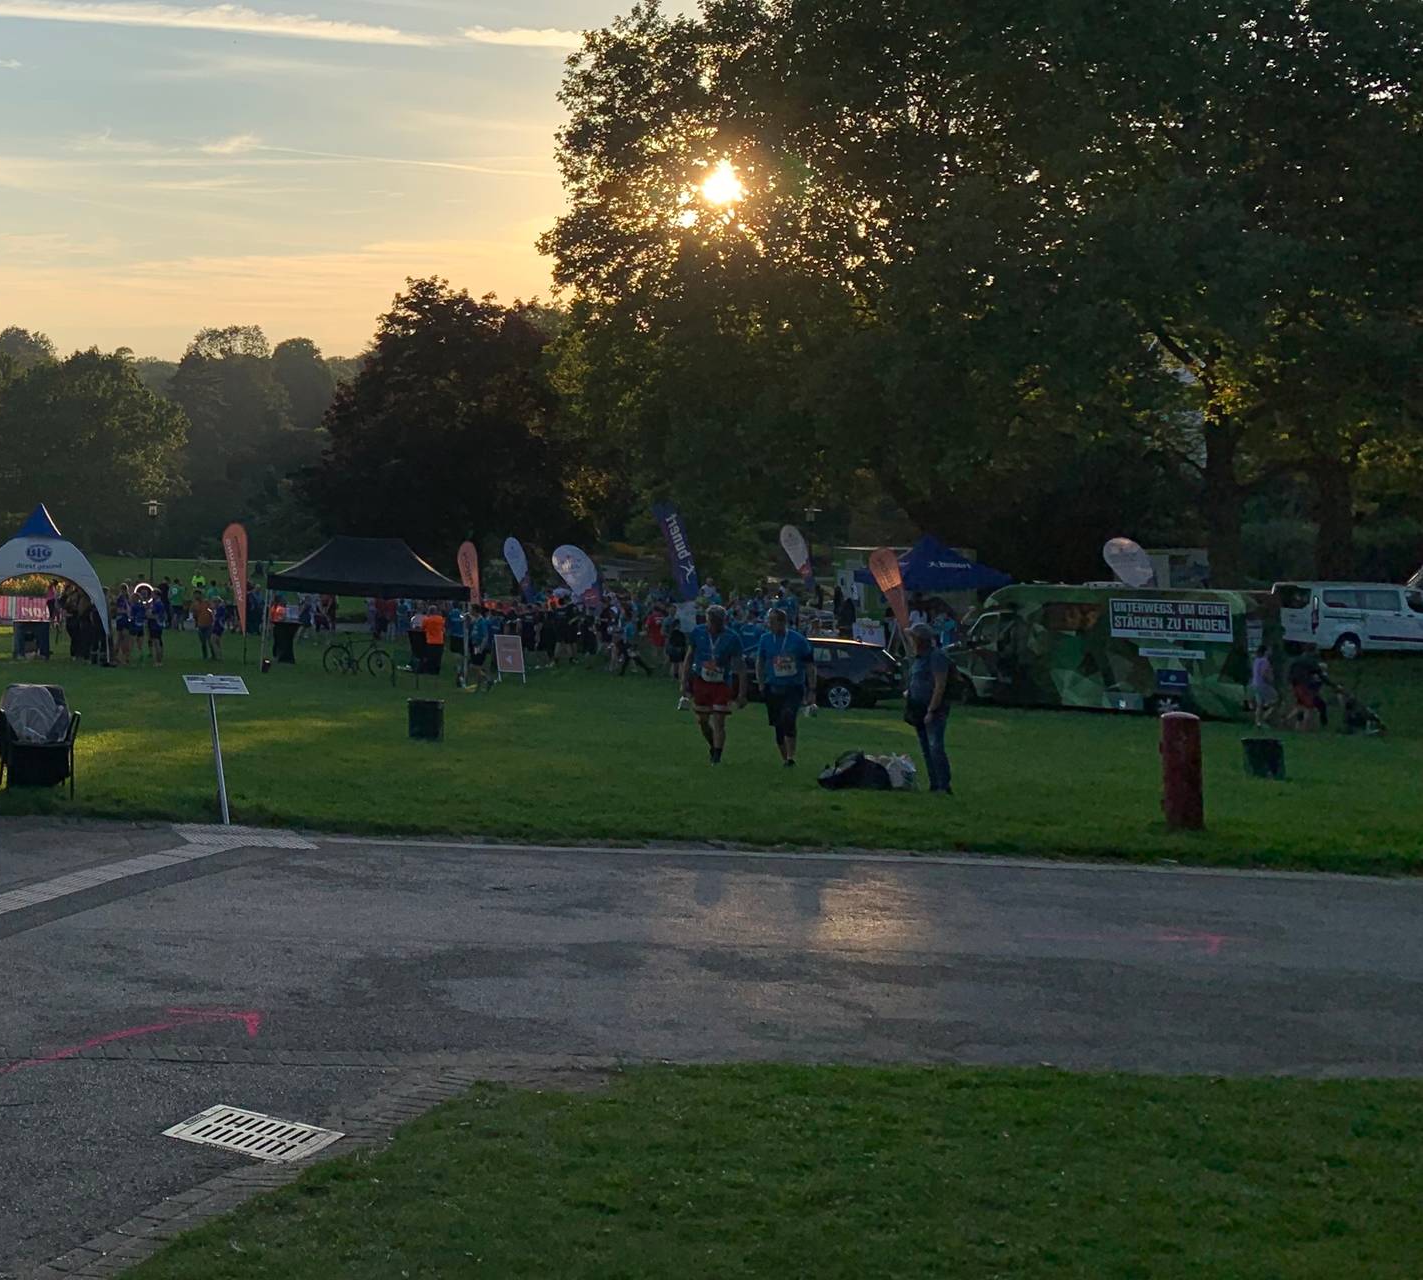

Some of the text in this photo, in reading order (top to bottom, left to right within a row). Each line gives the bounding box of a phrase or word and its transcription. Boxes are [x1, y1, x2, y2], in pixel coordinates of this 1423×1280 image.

[26, 547, 52, 558] BIG
[1113, 602, 1229, 616] UNTERWEGS, UM DEINE
[1114, 612, 1230, 632] STÄRKEN ZU FINDEN.
